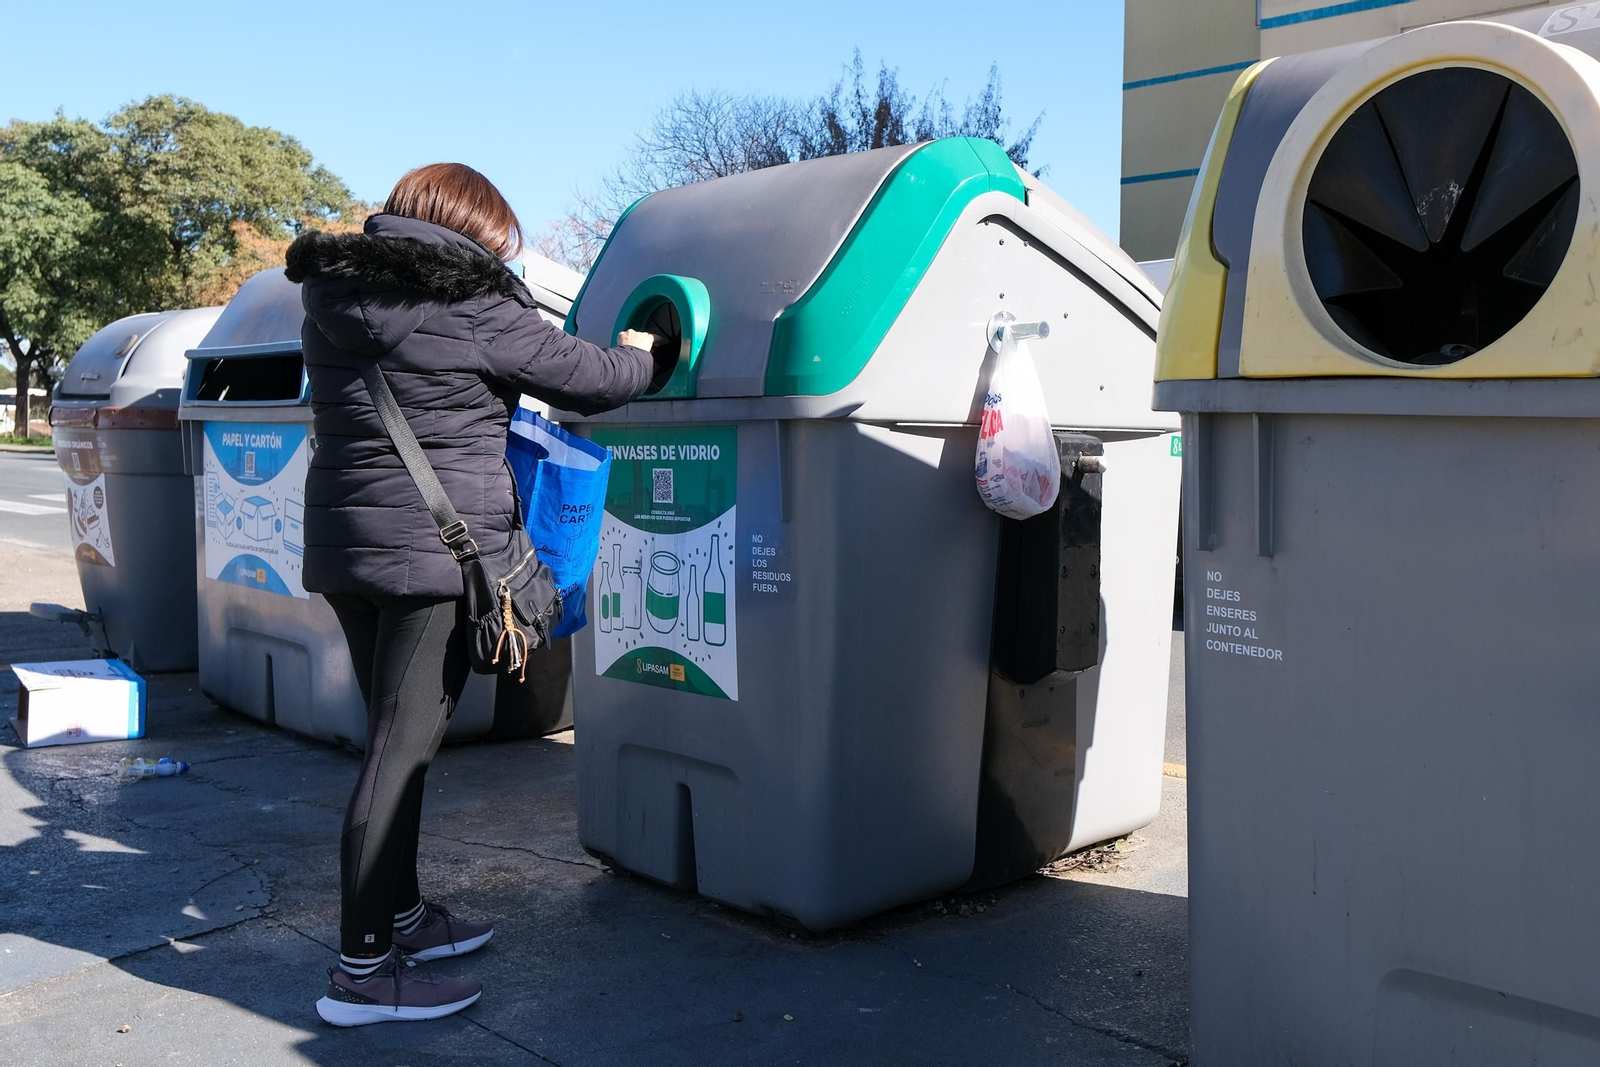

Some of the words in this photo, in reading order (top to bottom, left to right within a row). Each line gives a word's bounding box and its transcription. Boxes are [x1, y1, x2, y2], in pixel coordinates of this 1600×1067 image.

[222, 432, 244, 447] PAPEL
[244, 433, 250, 447] Y
[250, 431, 282, 449] CARTÓN
[660, 445, 676, 461] DE
[678, 444, 720, 461] VIDRIO
[752, 534, 763, 544] NO
[752, 546, 776, 557] DEJES
[752, 558, 768, 568] LOS
[752, 571, 791, 582] RESIDUOS
[1206, 570, 1222, 582] NO
[752, 583, 779, 594] FUERA
[1206, 587, 1241, 602] DEJES
[1206, 605, 1257, 622] ENSERES
[1206, 622, 1242, 637] JUNTO
[1243, 627, 1259, 640] AL
[1206, 639, 1283, 661] CONTENEDOR
[642, 662, 669, 676] LIPASAM
